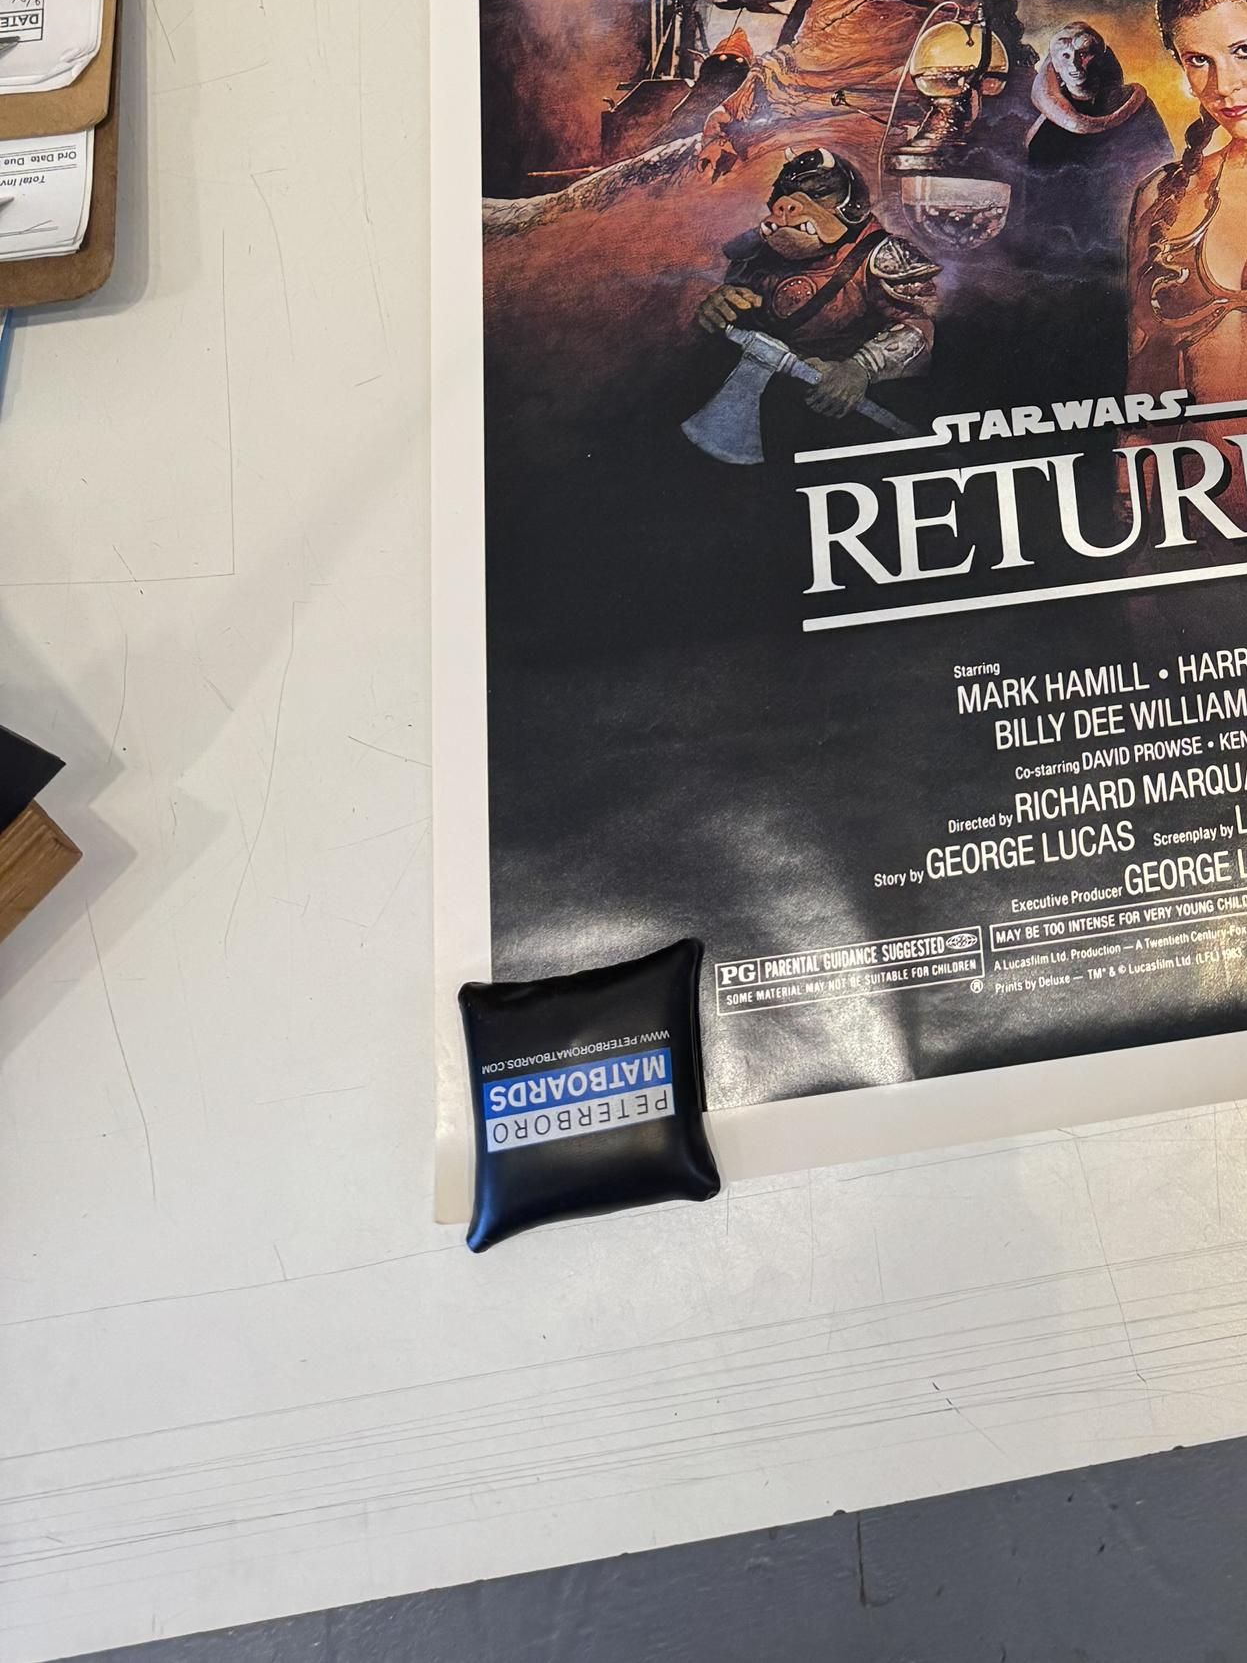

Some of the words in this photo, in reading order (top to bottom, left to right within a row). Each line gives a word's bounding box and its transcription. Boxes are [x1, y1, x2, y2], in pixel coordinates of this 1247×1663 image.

[0, 14, 39, 28] DATE
[932, 405, 1054, 445] STAR
[1052, 389, 1189, 431] WARS
[953, 661, 1000, 680] Starring
[957, 674, 1039, 715] MARK
[1045, 662, 1150, 702] HAMILL
[995, 711, 1066, 750] BILLY
[1074, 704, 1126, 739] DEE
[1015, 758, 1080, 780] Co-starring
[1082, 746, 1130, 772] DAVID
[1134, 736, 1203, 763] PROWSE
[948, 813, 996, 834] Directed
[999, 812, 1013, 828] by
[1015, 777, 1136, 824] RICHARD
[874, 870, 907, 888] Story
[909, 868, 924, 884] by
[925, 834, 1036, 880] GEORGE
[1041, 820, 1135, 863] LUCAS
[1153, 826, 1218, 848] Screenplay
[1220, 823, 1234, 839] by
[1011, 890, 1069, 913] Executive
[1071, 885, 1123, 906] Producer
[1124, 850, 1232, 896] GEORGE
[995, 928, 1022, 945] MAY
[1024, 924, 1041, 939] BE
[1043, 920, 1065, 937] TOO
[1068, 913, 1116, 934] INTENSE
[1118, 909, 1141, 926] FOR
[1143, 905, 1173, 923] VERY
[1175, 899, 1214, 918] YOUNG
[720, 963, 757, 985] PG
[765, 955, 820, 979] PARENTAL
[823, 946, 878, 971] GUIDANCE
[881, 936, 946, 963] SUGGESTED
[993, 961, 1002, 972] A
[1003, 953, 1049, 970] Lucasfilm
[1071, 942, 1121, 962] Production
[1135, 939, 1143, 951] A
[1144, 932, 1190, 950] Twentieth
[1024, 978, 1037, 991] by
[1038, 972, 1071, 988] Deluxe
[1128, 956, 1175, 975] Lucasfilm
[726, 991, 753, 1006] SOME
[756, 985, 802, 1002] MATERIAL
[864, 967, 909, 986] SUITABLE
[911, 963, 930, 978] FOR
[931, 958, 977, 975] CHILDREN
[482, 1029, 669, 1075] WWW.PETERBOROMATBOARDS.COM
[489, 1054, 666, 1112] MATBOARDS
[493, 1090, 667, 1144] PETERBORO
